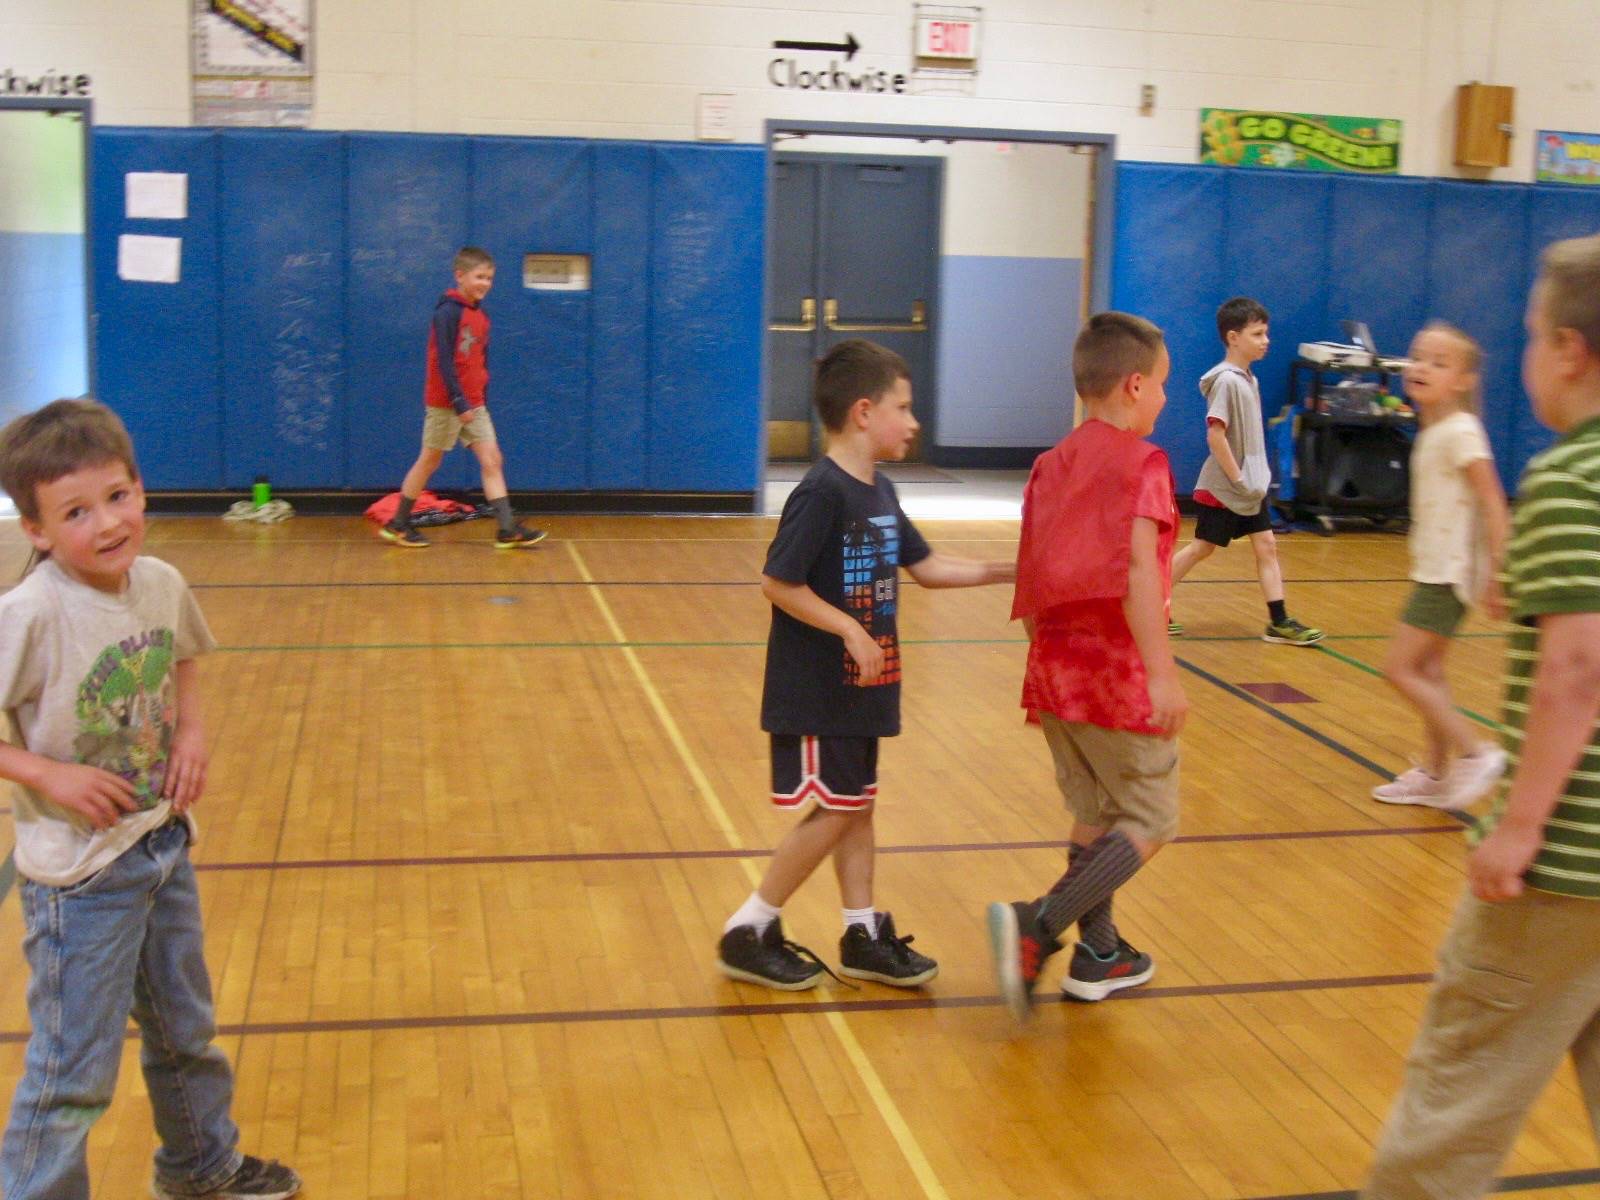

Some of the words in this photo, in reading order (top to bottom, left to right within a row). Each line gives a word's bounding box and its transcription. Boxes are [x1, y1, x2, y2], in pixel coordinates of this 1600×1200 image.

[929, 21, 972, 53] EXIT
[0, 68, 91, 96] kwise
[767, 57, 906, 94] Clockwise
[1238, 116, 1287, 139] GO
